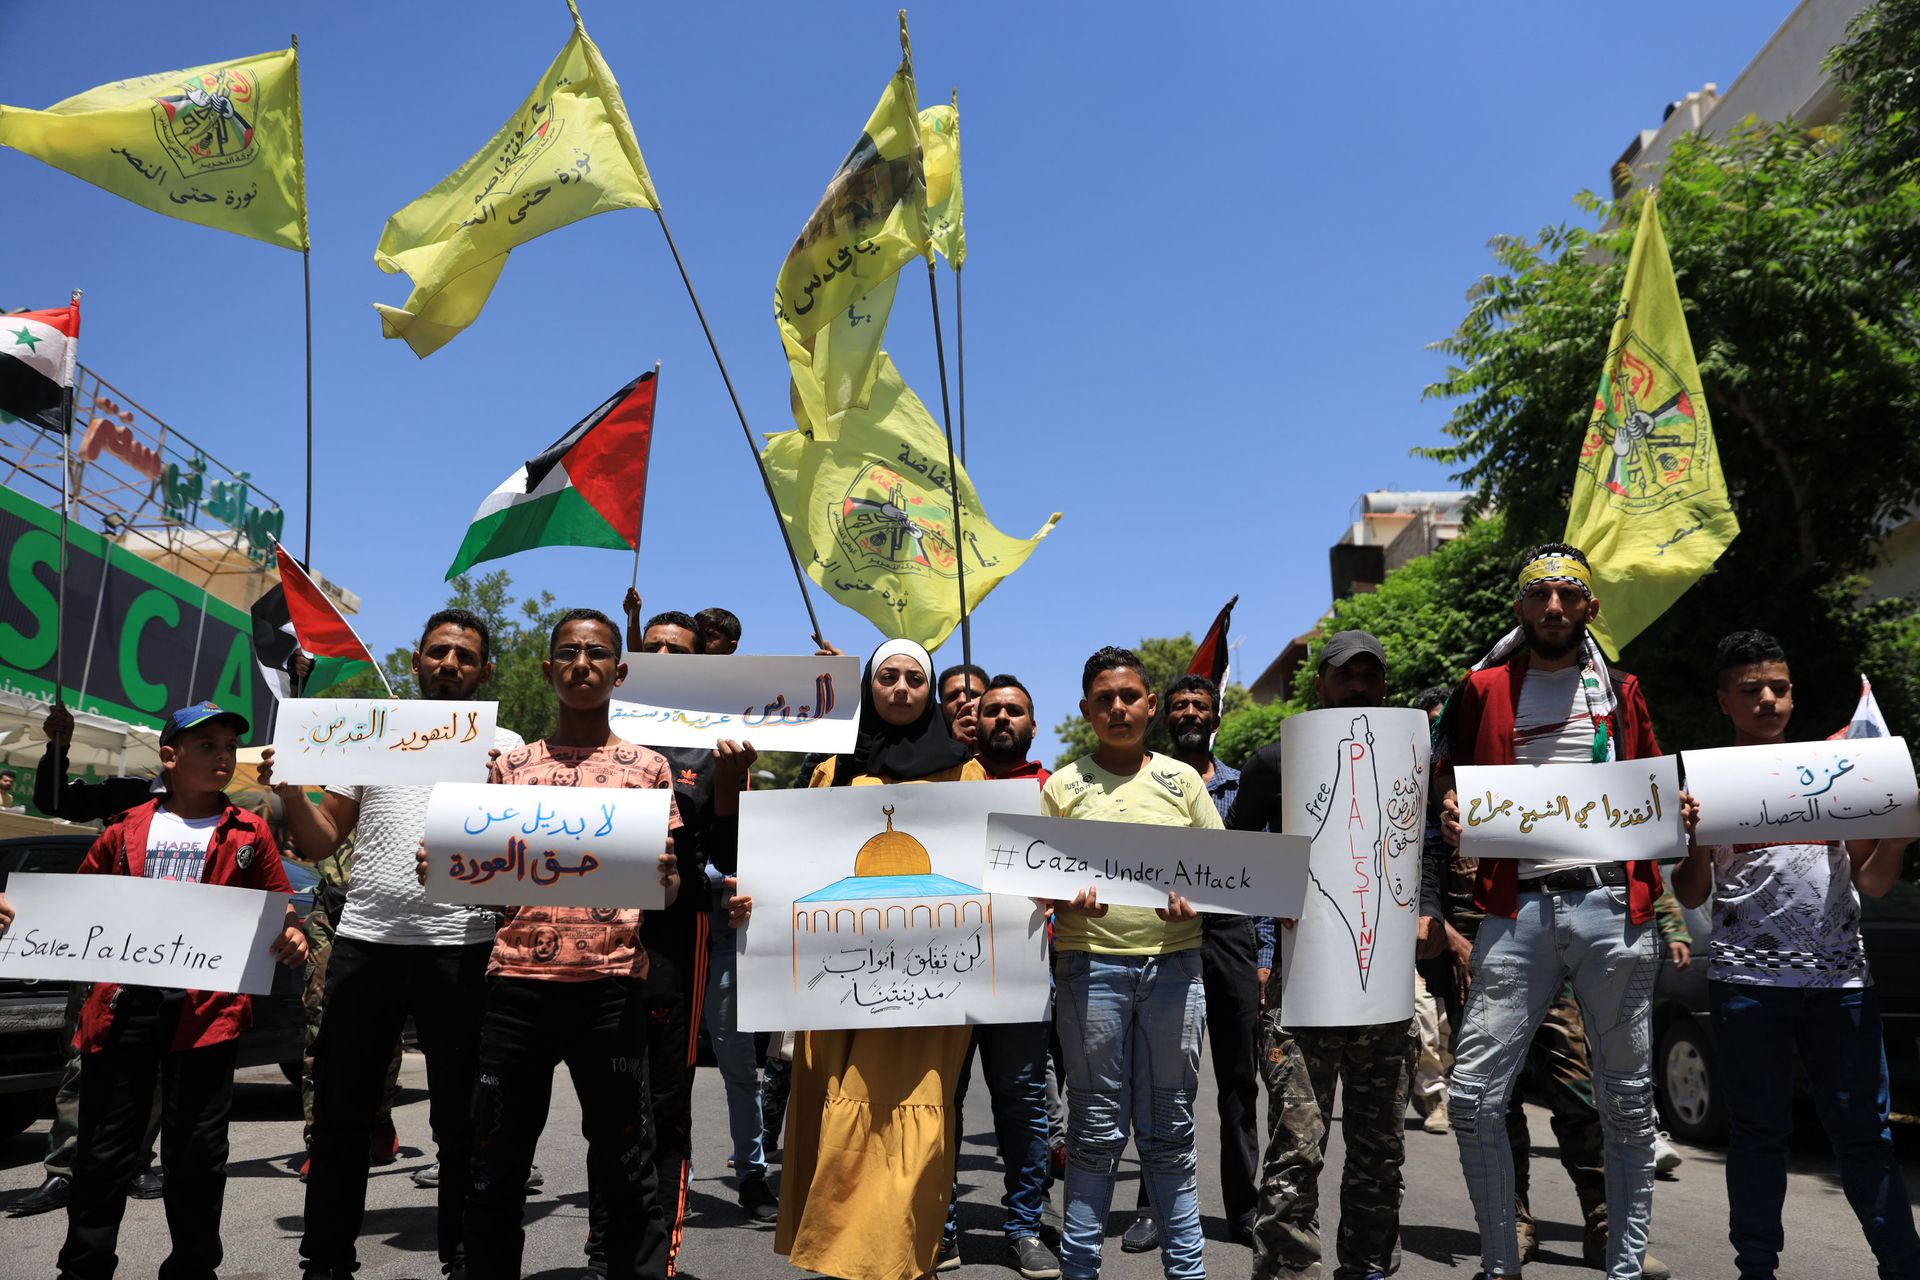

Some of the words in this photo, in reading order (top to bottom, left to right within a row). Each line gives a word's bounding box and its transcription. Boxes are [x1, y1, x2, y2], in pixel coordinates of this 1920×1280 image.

[110, 146, 168, 186] النصر
[553, 147, 592, 185] ثورة
[169, 187, 217, 205] حتى
[224, 181, 258, 211] ثورة
[507, 186, 552, 225] حتى
[834, 579, 875, 591] حتى
[743, 673, 835, 728] القدس
[311, 707, 386, 744] القدس
[1796, 753, 1855, 797] غزة
[464, 805, 520, 836] عن
[594, 802, 617, 837] لا
[1305, 782, 1331, 822] free
[1467, 790, 1514, 827] جراح
[1518, 795, 1571, 834] الشيخ
[1827, 793, 1902, 820] تحت
[521, 801, 586, 841] بديل
[449, 835, 528, 885] العودة
[530, 849, 600, 886] حق
